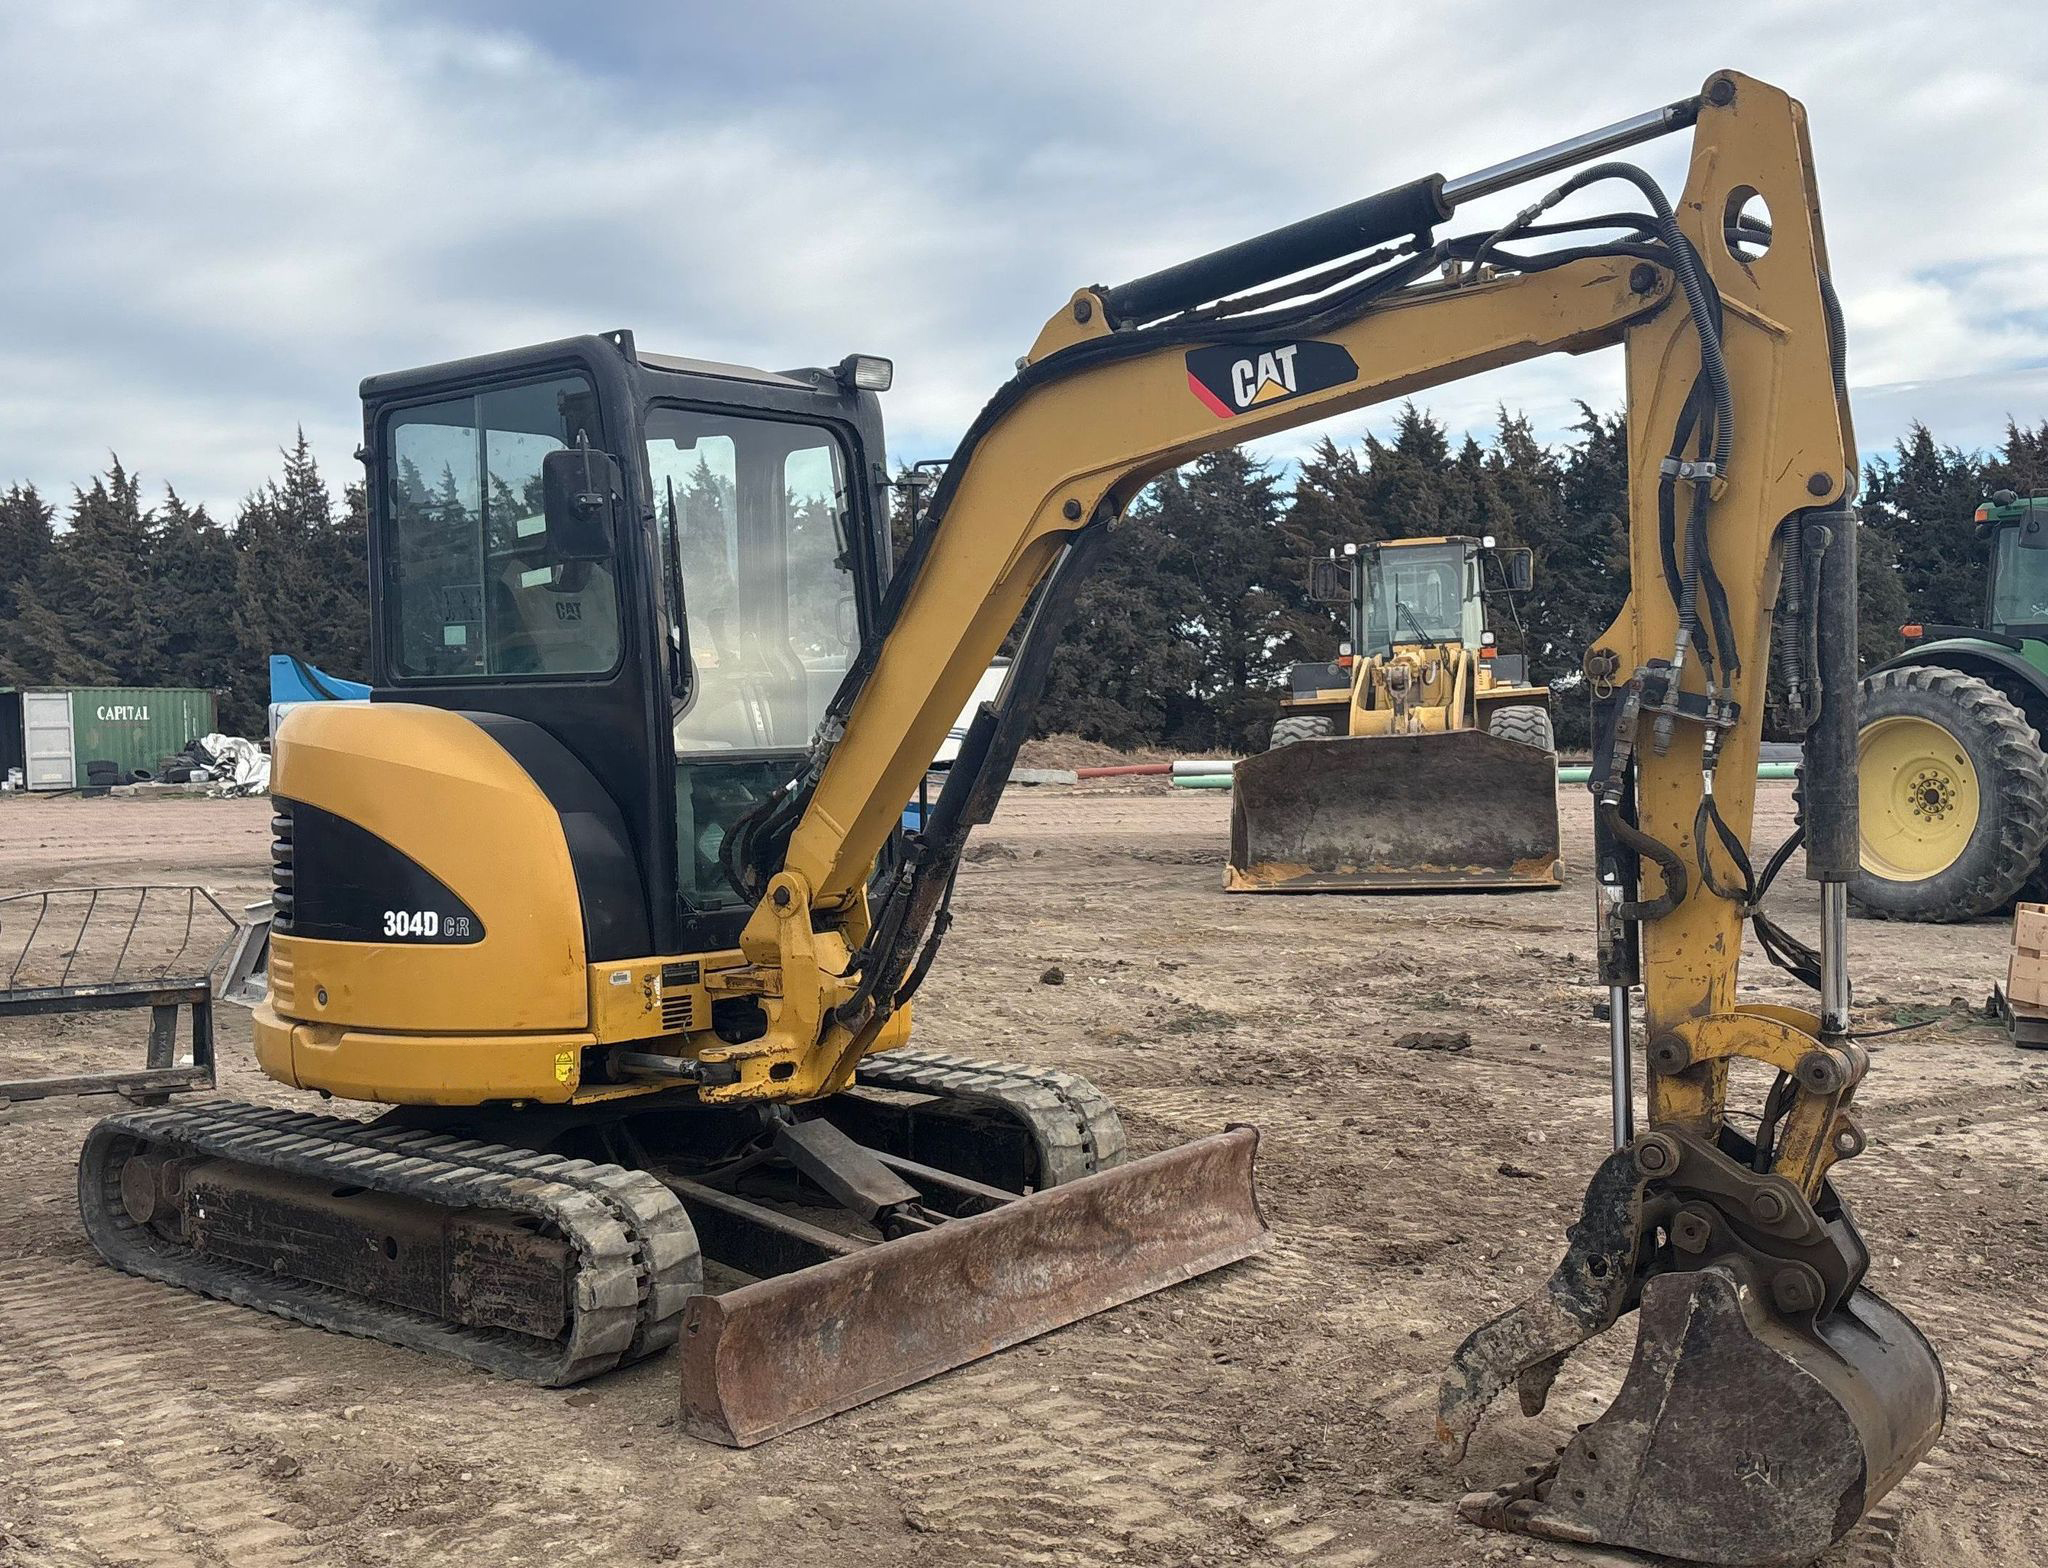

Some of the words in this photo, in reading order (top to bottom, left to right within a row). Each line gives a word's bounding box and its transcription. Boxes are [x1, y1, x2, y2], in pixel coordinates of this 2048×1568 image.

[1231, 344, 1297, 407] CAT
[556, 602, 581, 620] CAT
[96, 705, 150, 720] CAPITAL
[383, 911, 438, 936] 304D
[443, 917, 470, 937] CR
